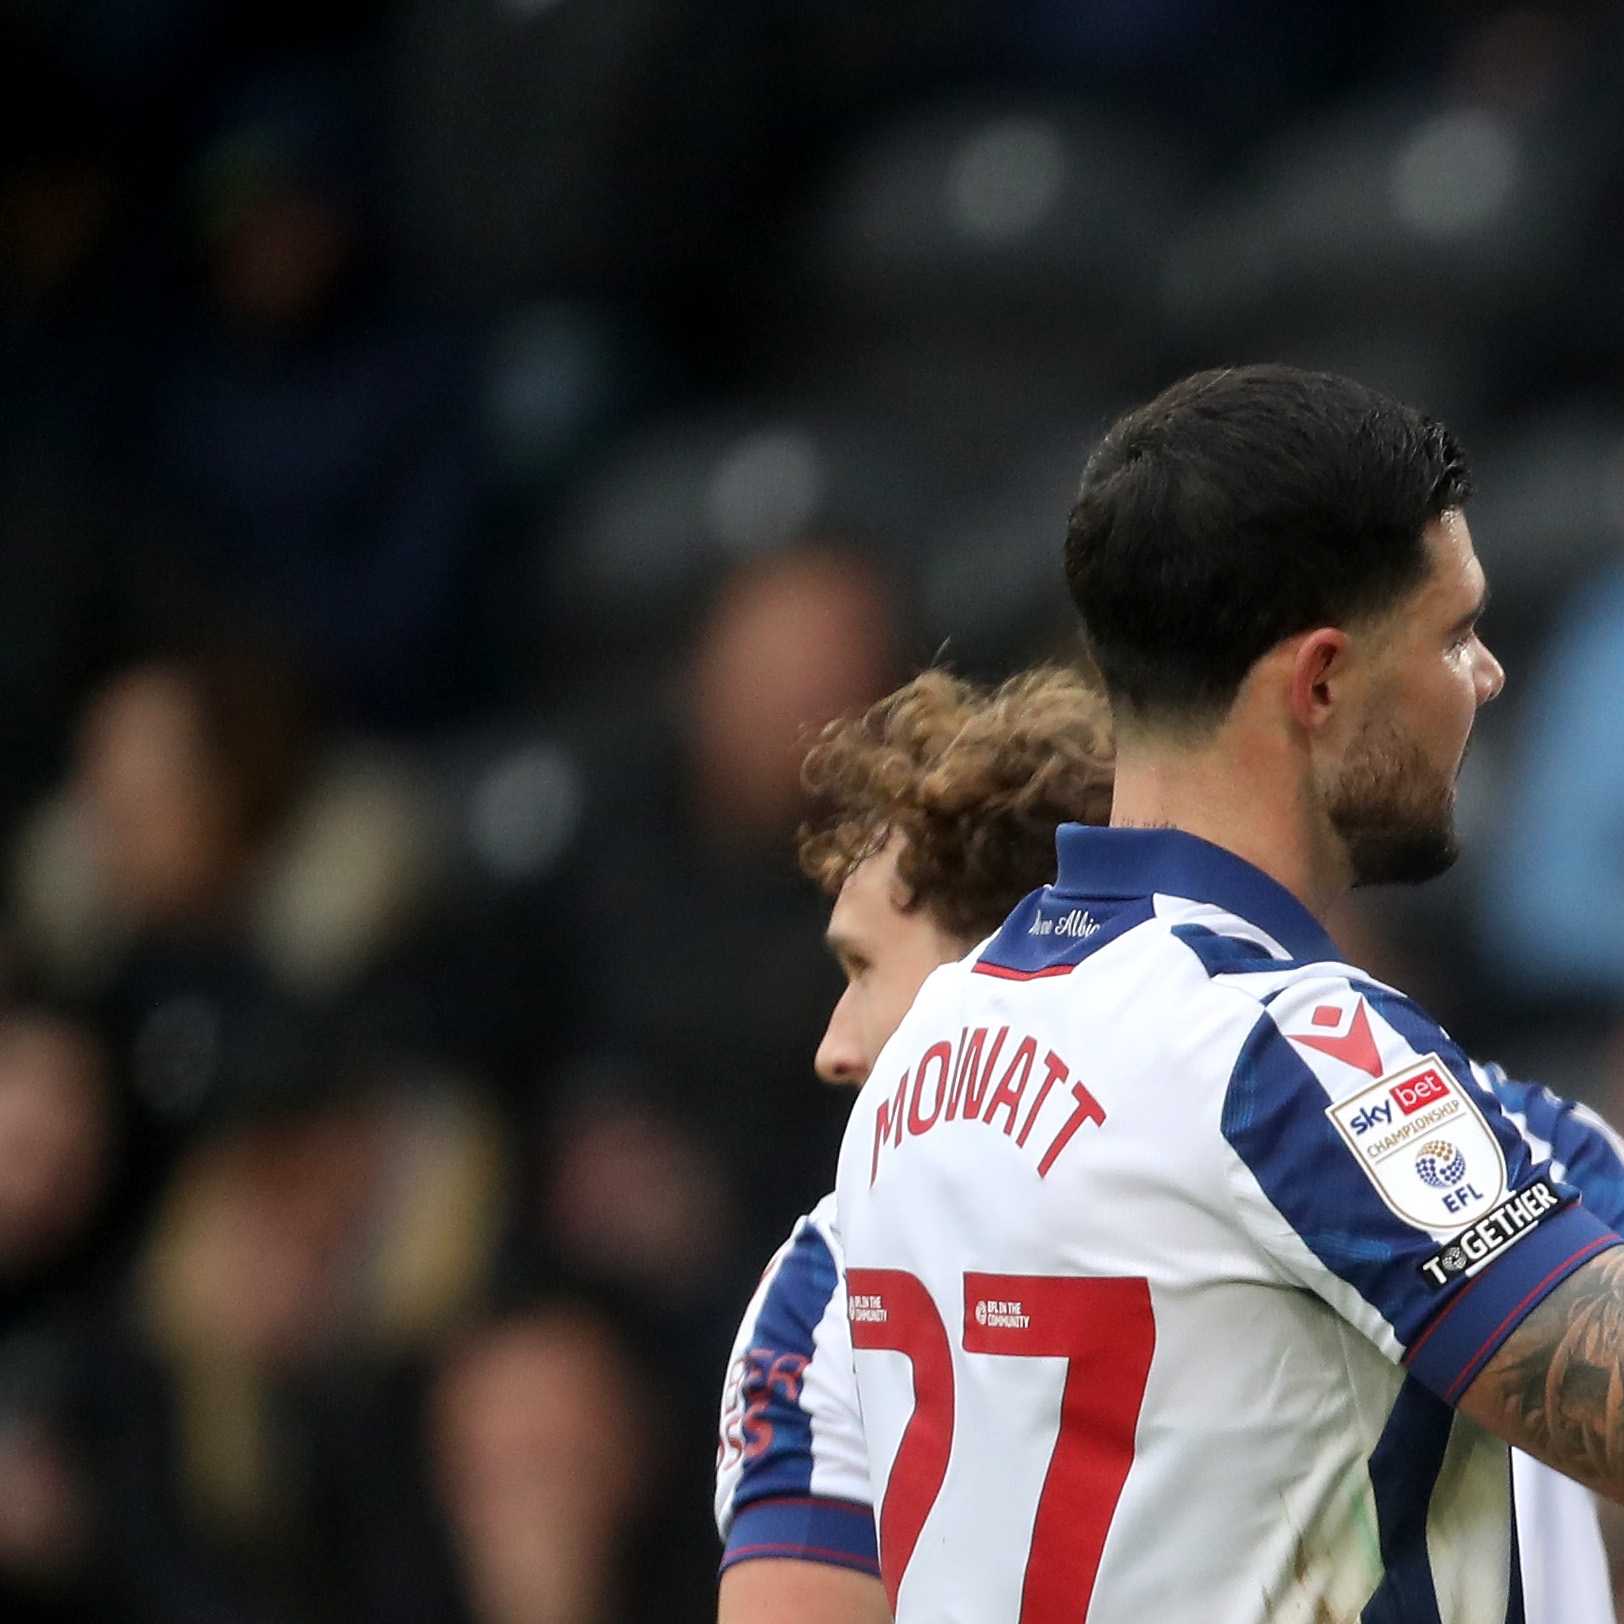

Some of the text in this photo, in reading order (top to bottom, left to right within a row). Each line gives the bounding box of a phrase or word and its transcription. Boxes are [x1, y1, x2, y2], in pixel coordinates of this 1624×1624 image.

[870, 1025, 1107, 1190] MOWATT
[1350, 1074, 1443, 1135] sky bet
[1366, 1099, 1461, 1158] CHAMPIONSHIP
[1441, 1183, 1484, 1214] EFL
[1422, 1181, 1558, 1284] TOGETHER
[1007, 1302, 1022, 1315] THE
